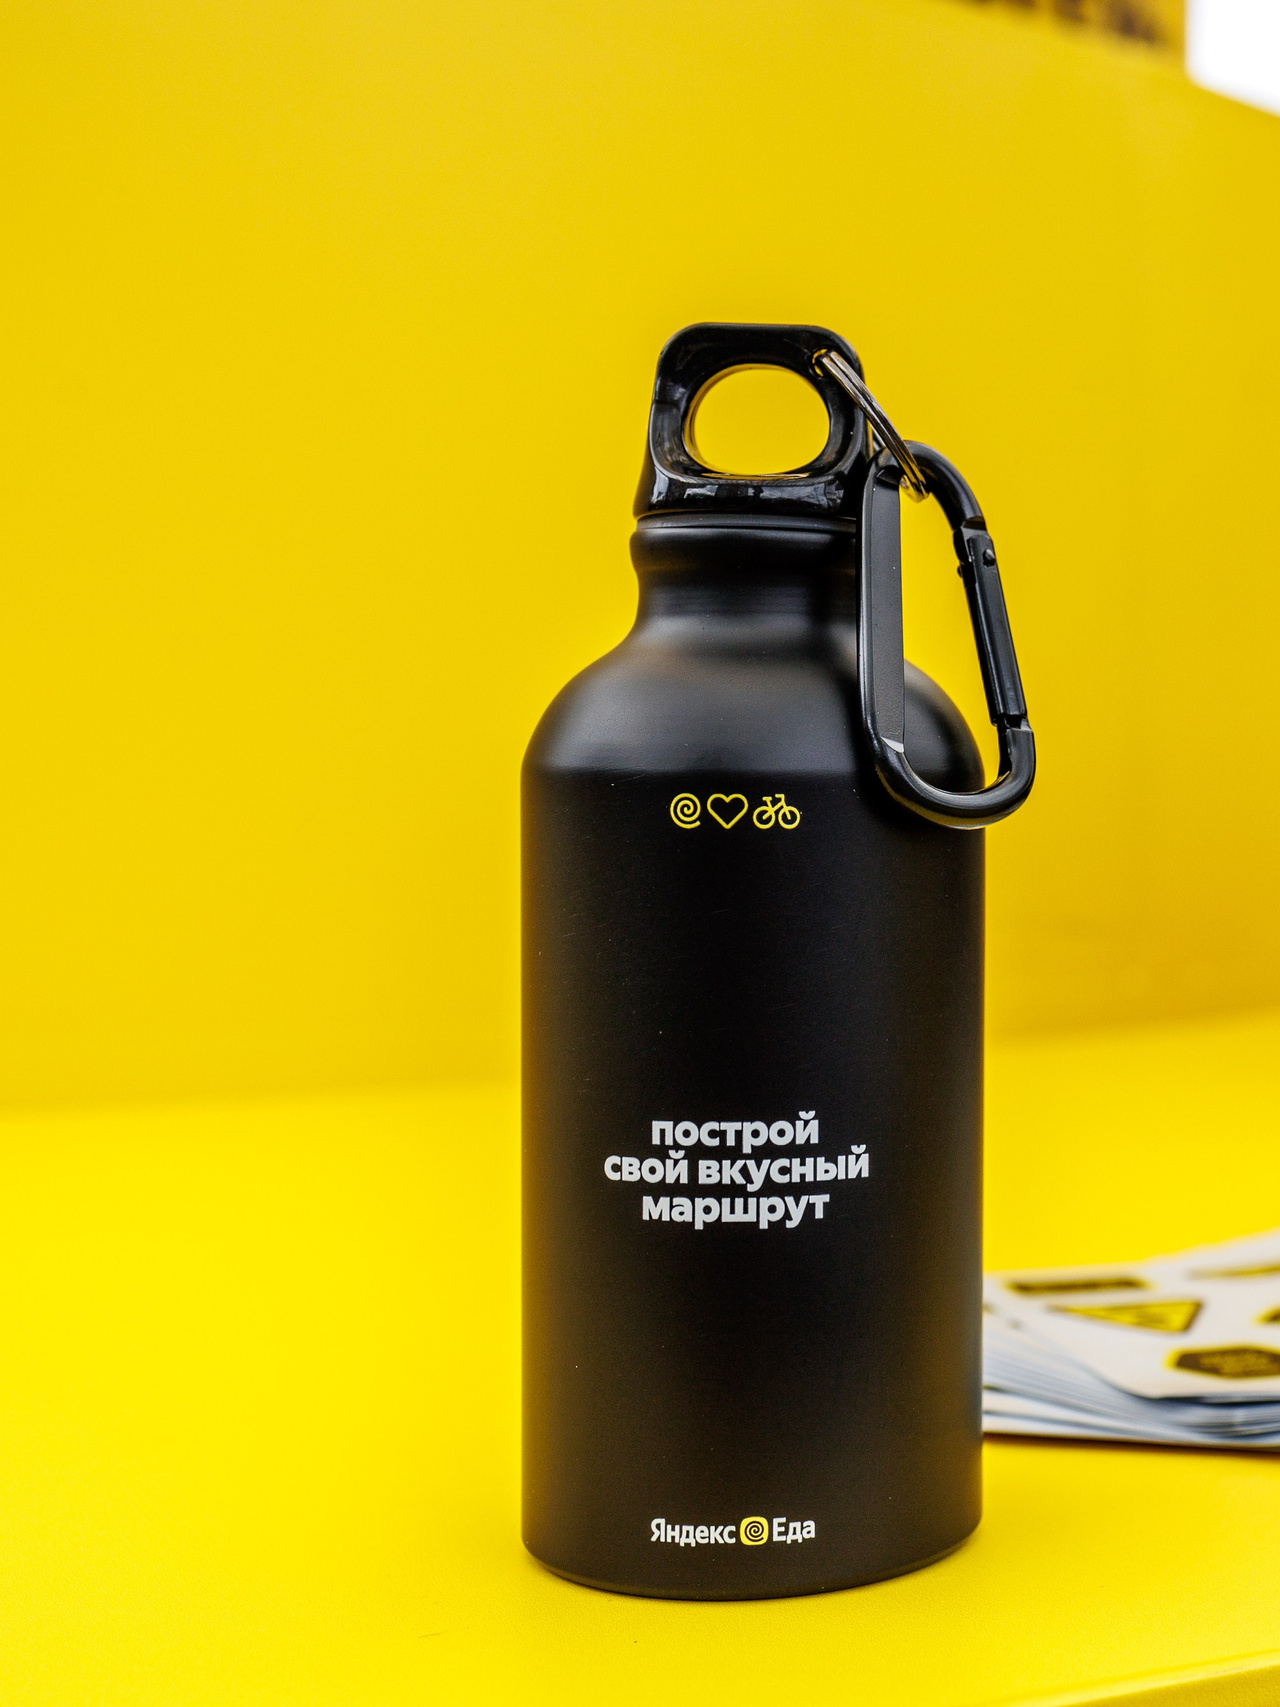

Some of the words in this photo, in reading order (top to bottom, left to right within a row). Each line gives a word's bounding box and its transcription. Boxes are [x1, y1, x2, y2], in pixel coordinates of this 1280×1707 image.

[651, 1110, 819, 1154] построй
[603, 1149, 689, 1184] свой
[698, 1144, 870, 1193] вкусный
[642, 1193, 831, 1230] маршрут
[650, 1517, 737, 1547] Яндекс
[772, 1516, 816, 1544] Еда
